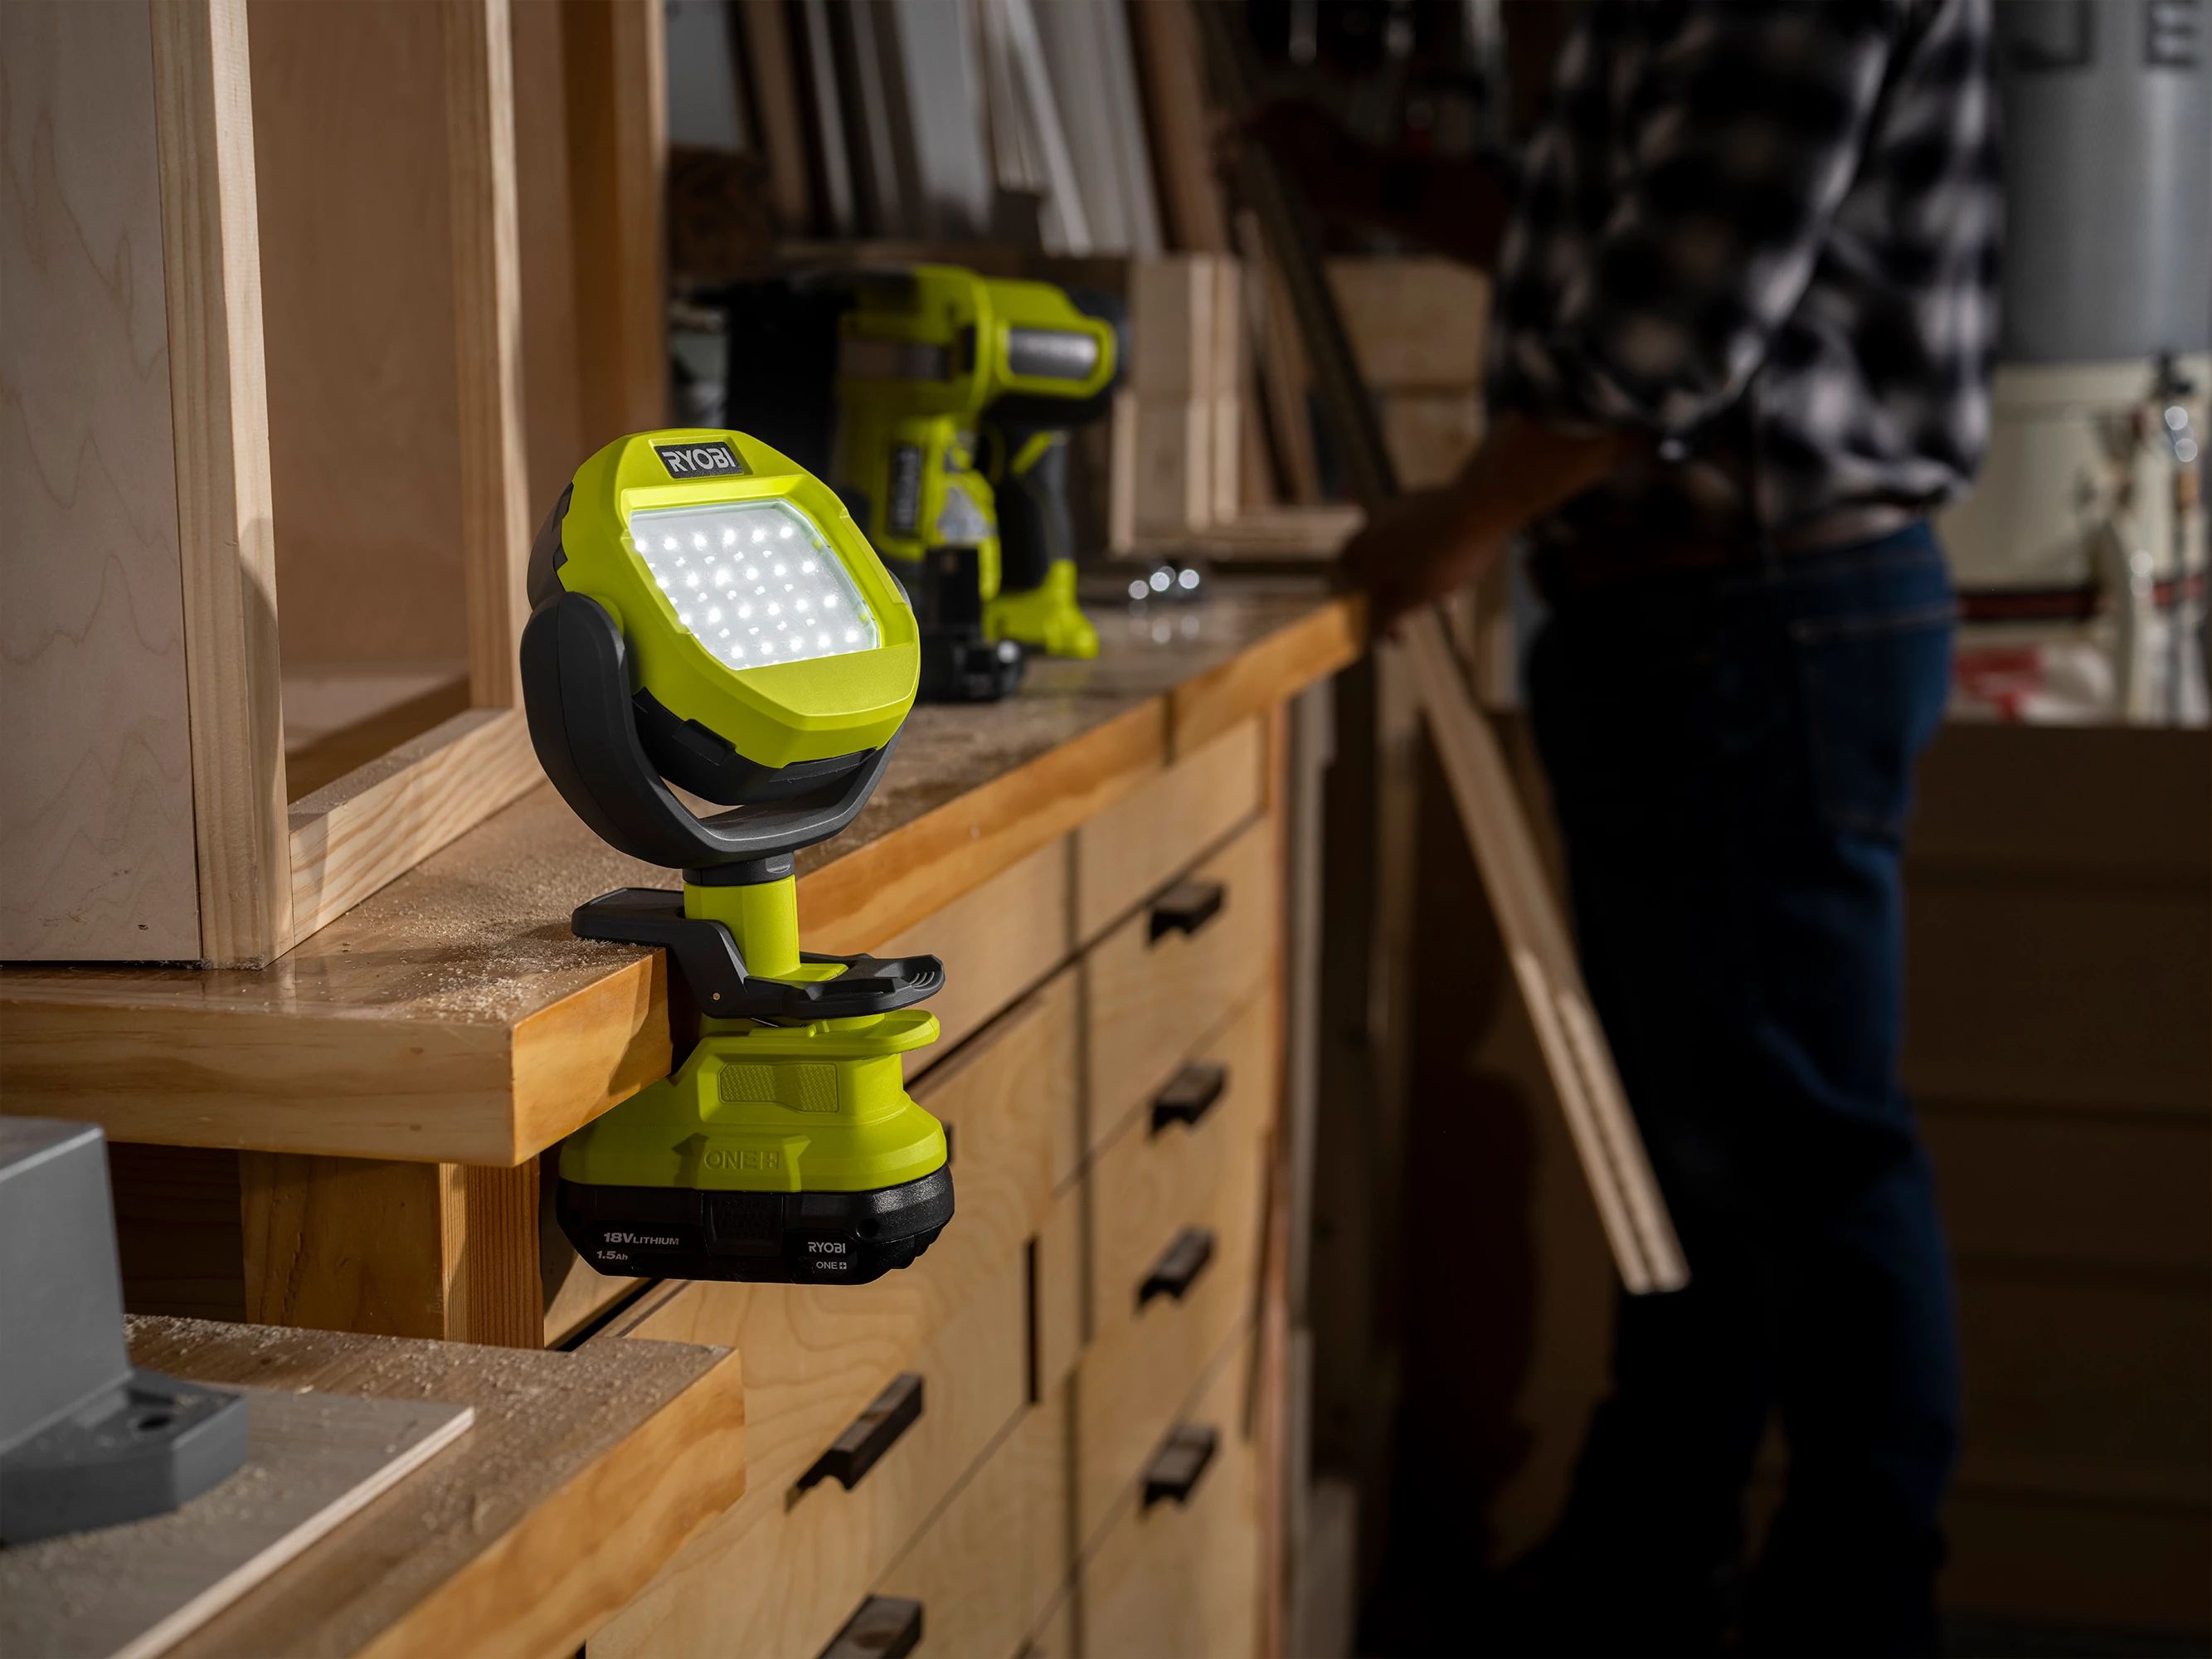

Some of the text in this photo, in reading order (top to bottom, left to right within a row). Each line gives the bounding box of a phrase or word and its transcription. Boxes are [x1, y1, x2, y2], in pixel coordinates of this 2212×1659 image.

[662, 447, 737, 472] RYOBI
[808, 1241, 846, 1253] RYOBI
[597, 1250, 628, 1260] 1.5Ah
